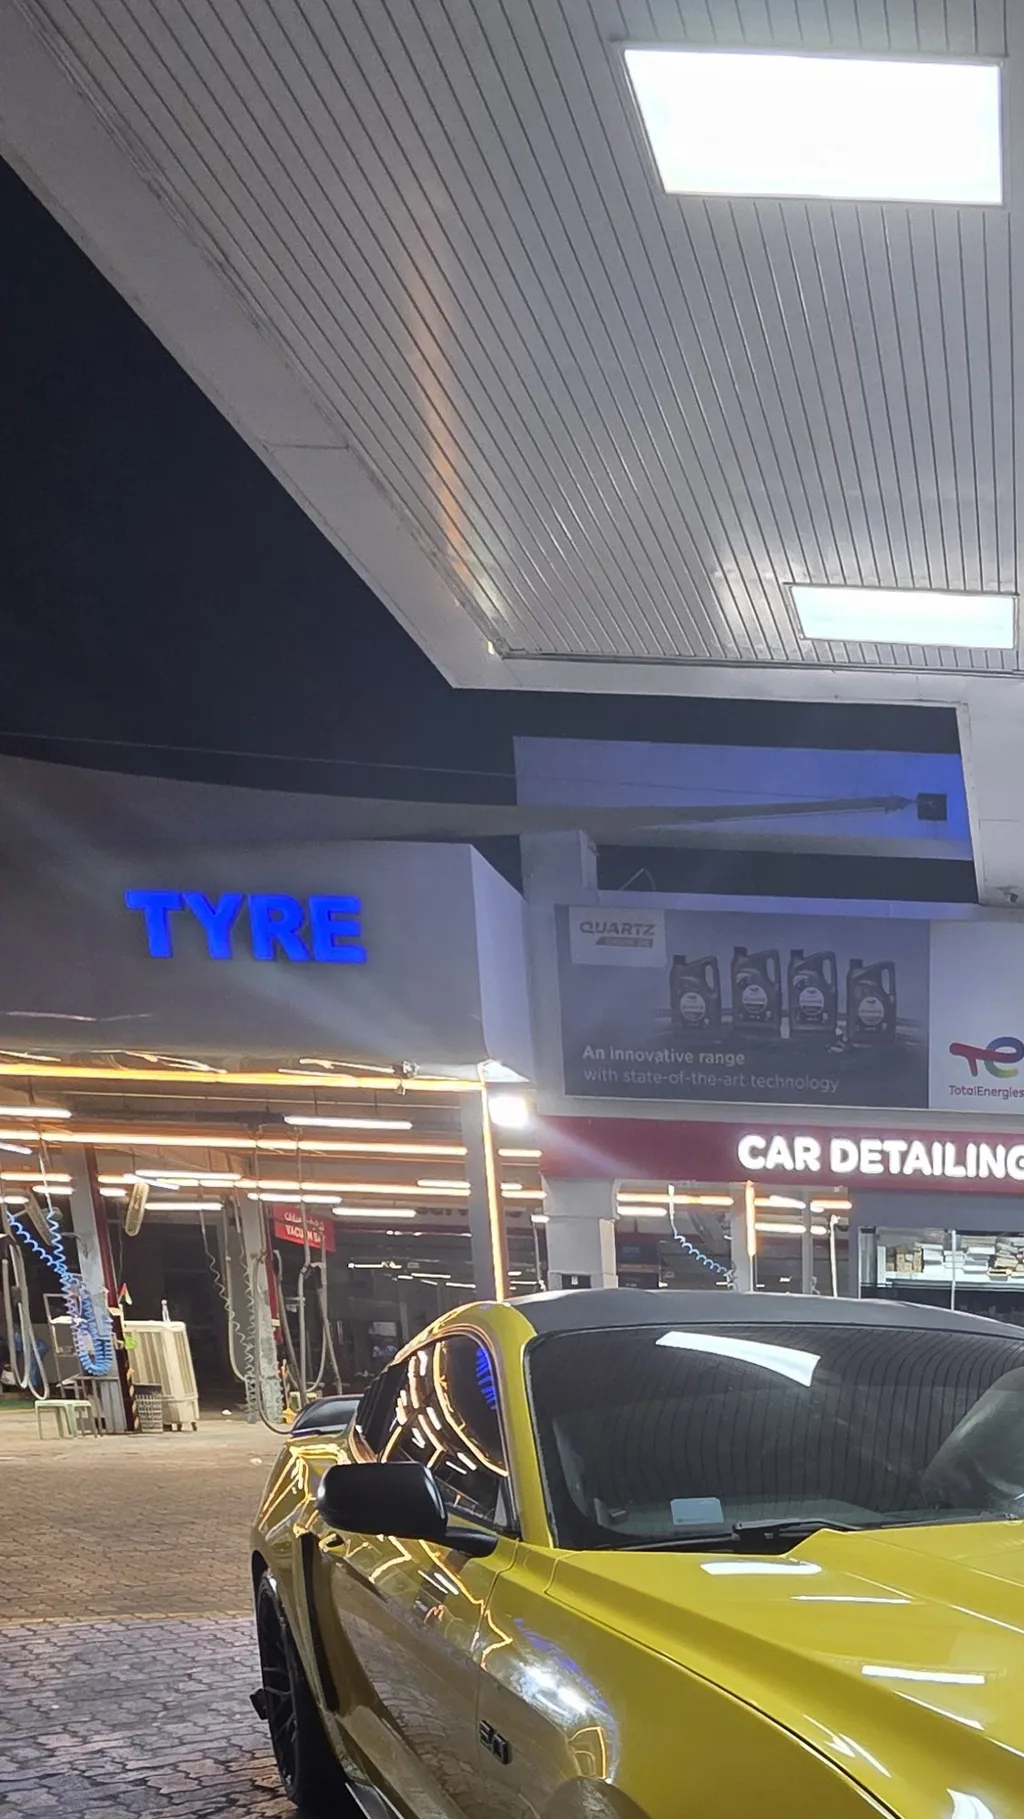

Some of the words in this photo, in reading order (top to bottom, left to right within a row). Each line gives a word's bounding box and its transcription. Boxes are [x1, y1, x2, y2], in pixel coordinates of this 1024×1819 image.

[124, 889, 368, 964] TYRE
[579, 920, 656, 937] QUARTZ
[582, 1045, 606, 1061] An
[698, 1053, 746, 1068] range
[584, 1067, 618, 1084] with
[622, 1070, 746, 1088] state-of-the-art
[749, 1076, 840, 1094] technology
[737, 1134, 822, 1172] CAR
